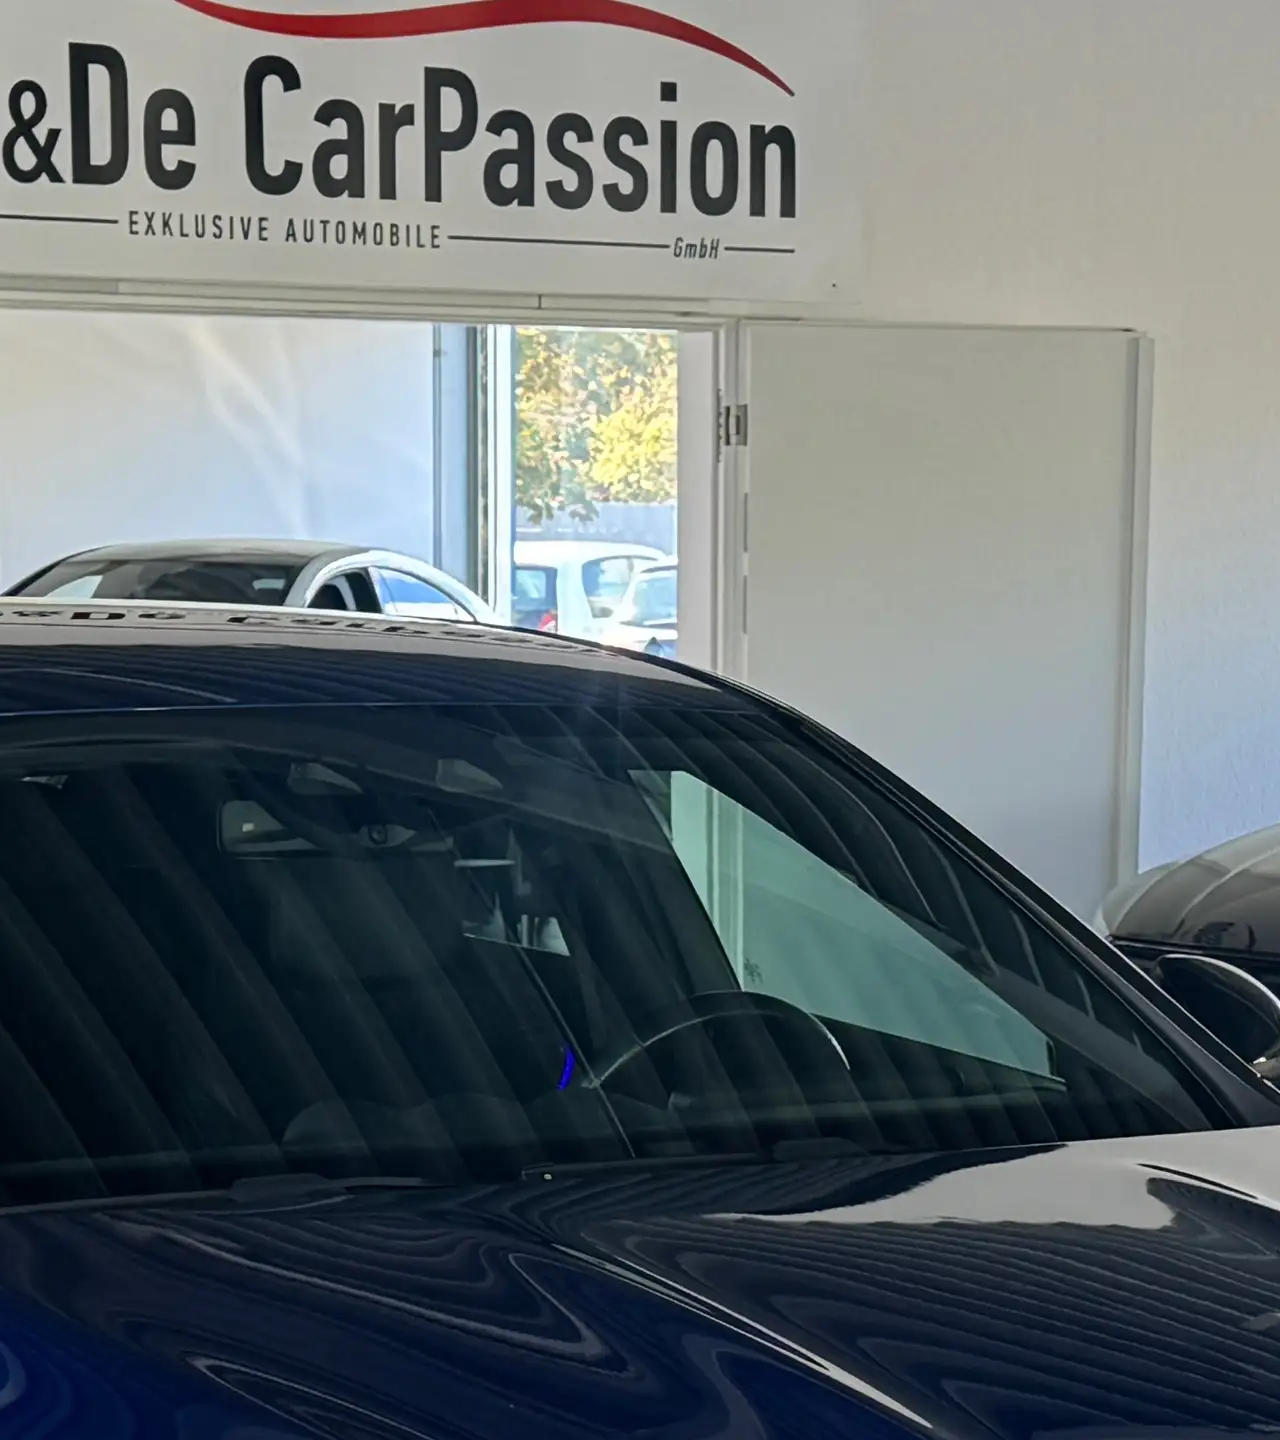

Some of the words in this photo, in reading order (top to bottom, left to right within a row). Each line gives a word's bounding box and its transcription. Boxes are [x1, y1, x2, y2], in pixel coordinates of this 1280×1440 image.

[243, 54, 796, 219] CarPassion
[128, 210, 269, 242] EXKLUSIVE
[284, 217, 441, 249] AUTOMOBILE
[673, 236, 720, 260] GmbH
